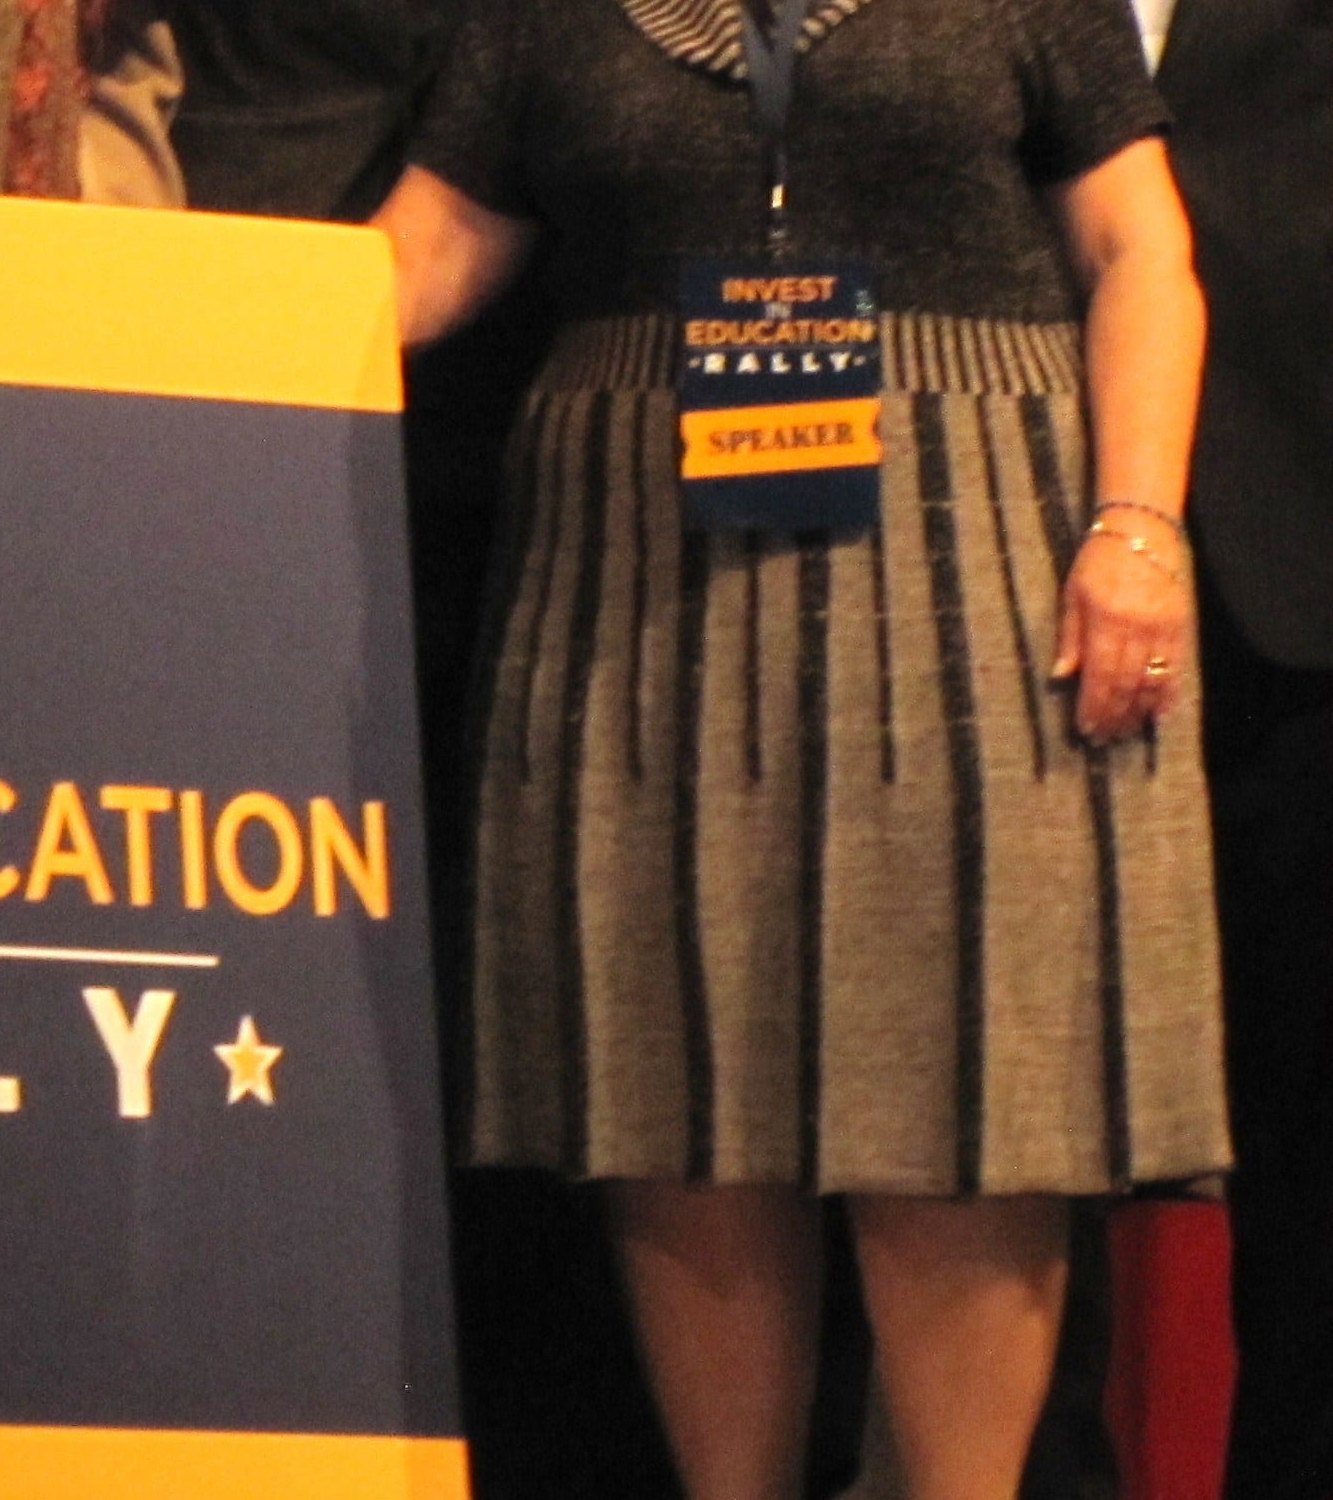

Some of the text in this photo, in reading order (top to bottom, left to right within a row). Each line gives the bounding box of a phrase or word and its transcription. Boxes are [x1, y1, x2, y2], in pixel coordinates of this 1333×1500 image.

[722, 275, 837, 303] INVEST
[684, 318, 876, 346] EDUCATION
[702, 351, 851, 375] RALLY
[708, 419, 855, 454] SPEAKER
